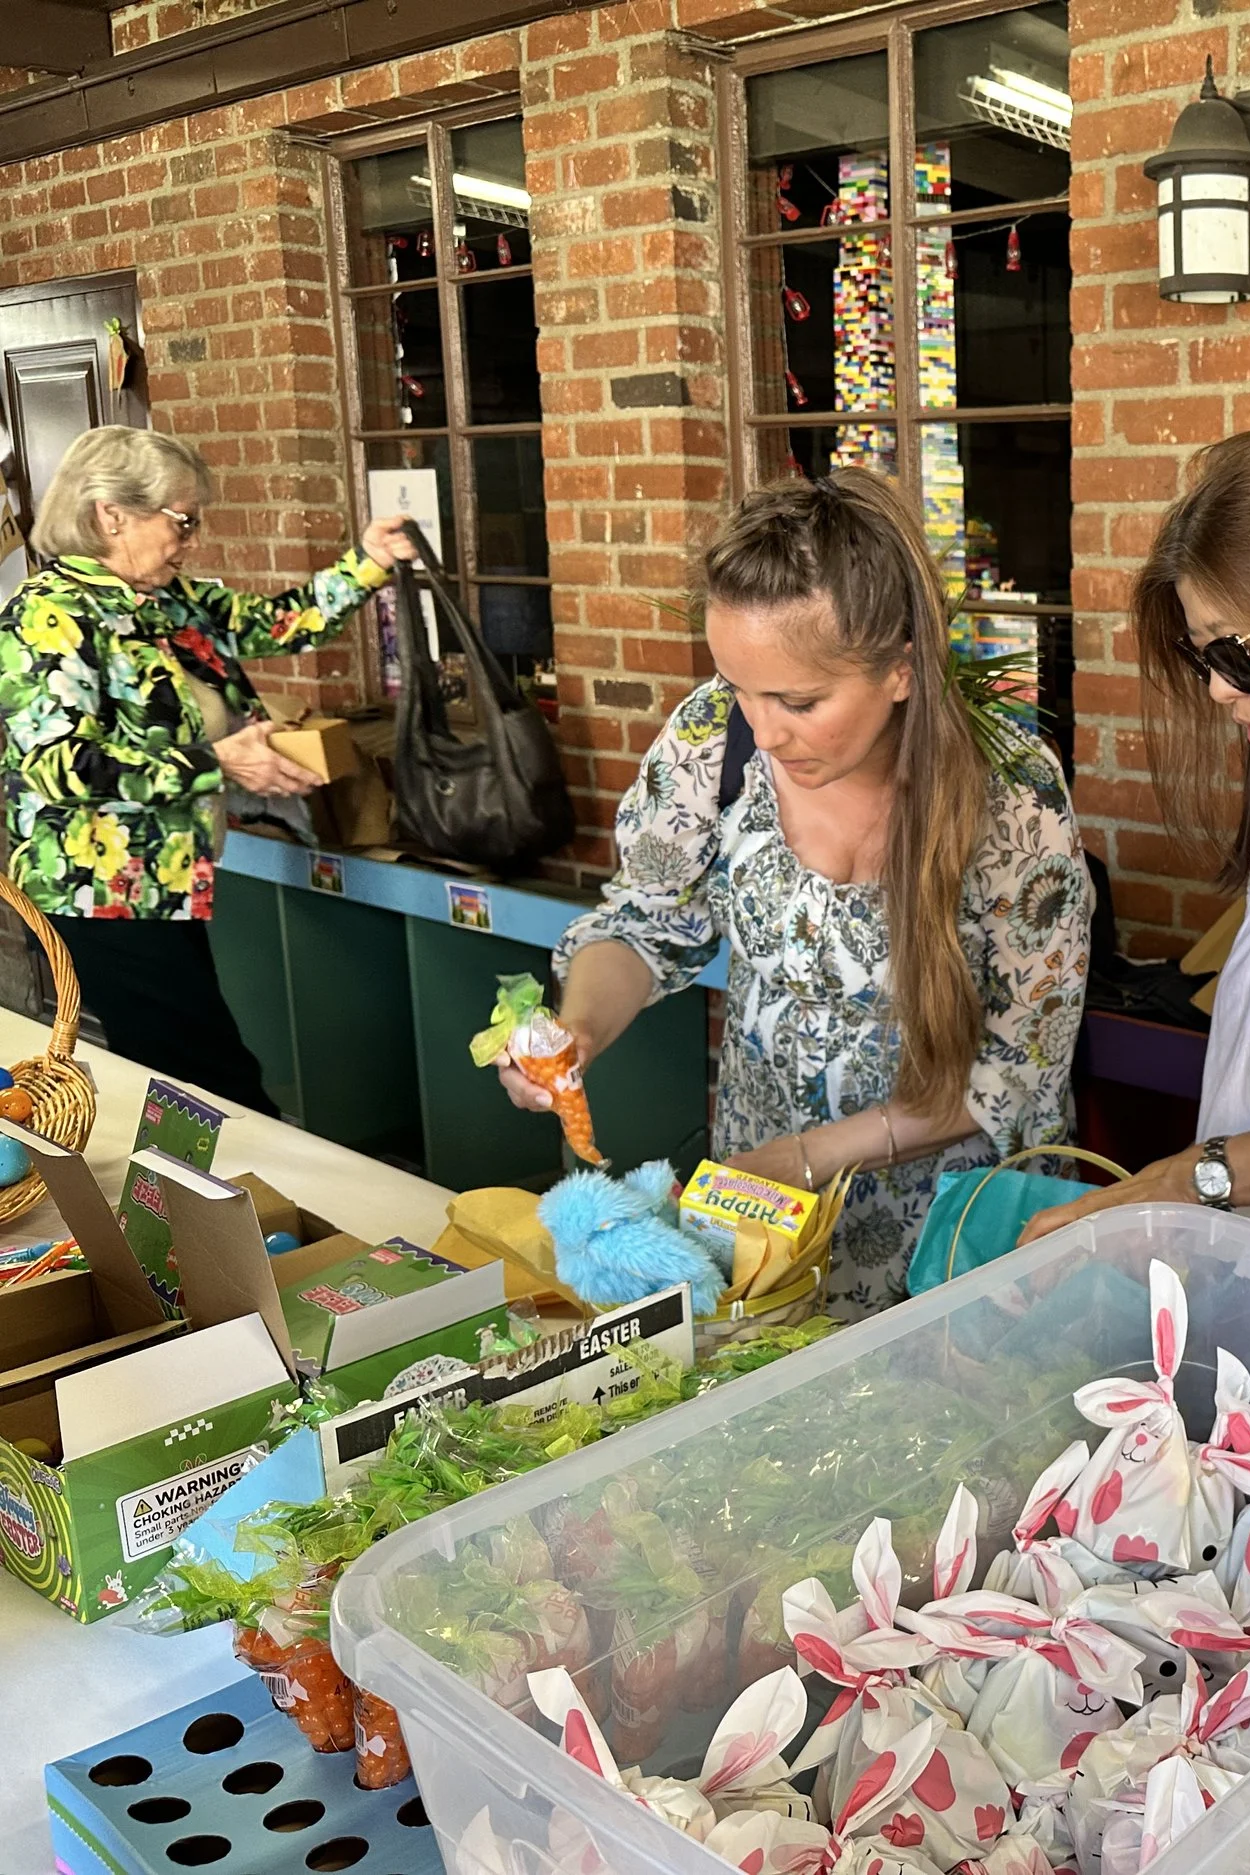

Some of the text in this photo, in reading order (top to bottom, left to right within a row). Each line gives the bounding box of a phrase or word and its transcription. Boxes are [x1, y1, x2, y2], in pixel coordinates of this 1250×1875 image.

[706, 1189, 779, 1225] Hippy
[608, 1381, 628, 1398] This
[134, 1477, 242, 1529] CHOKING HAZAR
[134, 1522, 161, 1540] Small
[136, 1531, 164, 1548] under
[168, 1526, 174, 1535] 3
